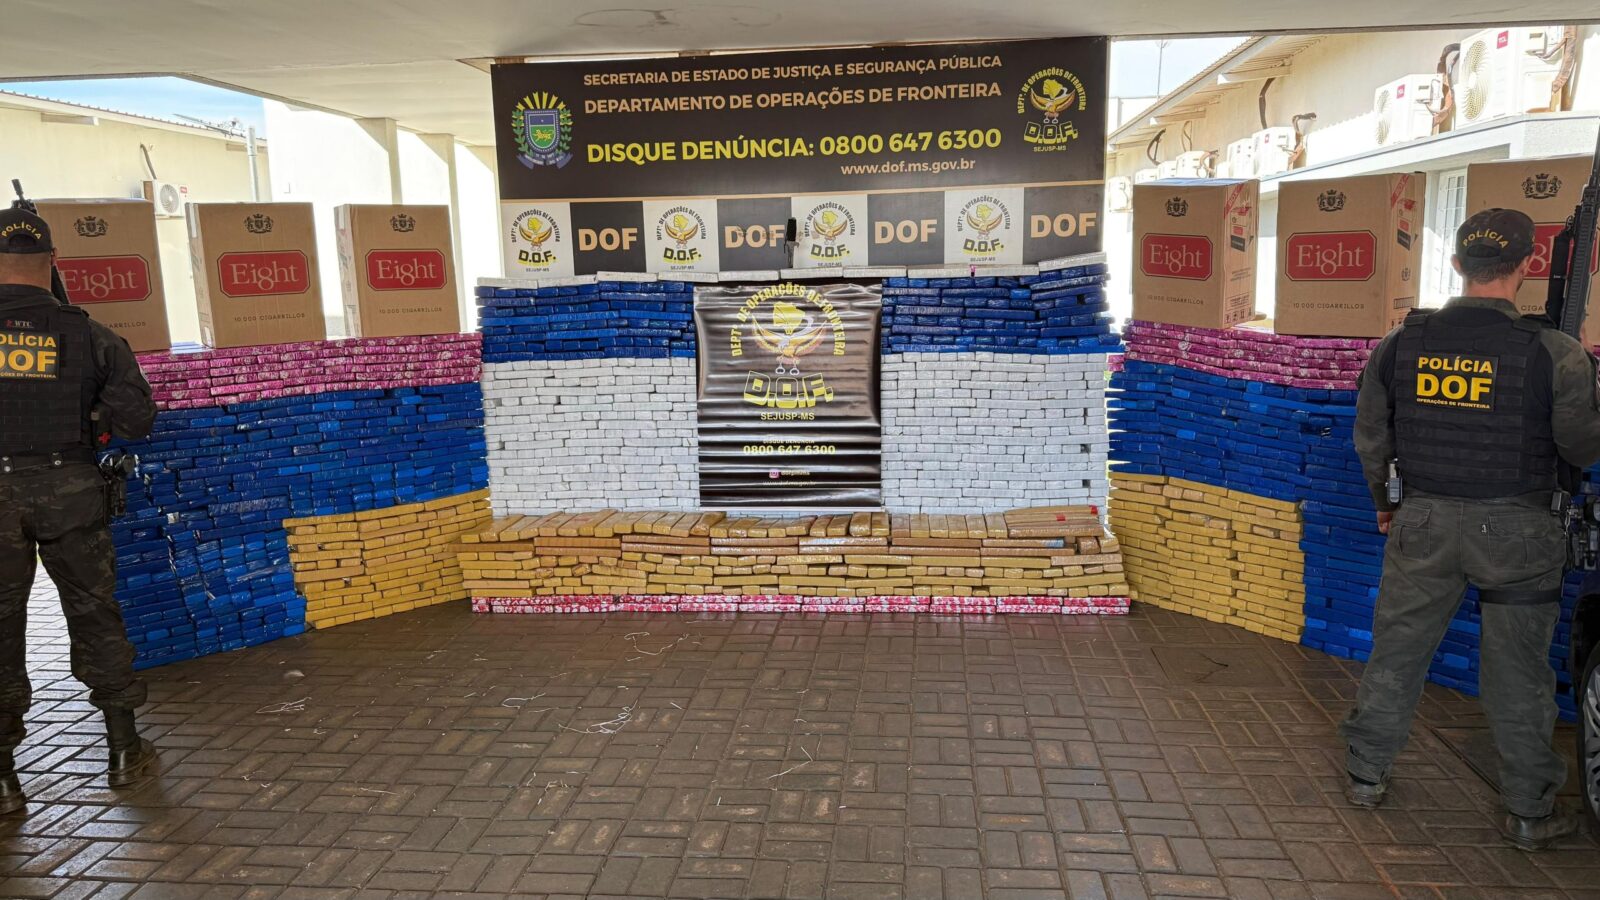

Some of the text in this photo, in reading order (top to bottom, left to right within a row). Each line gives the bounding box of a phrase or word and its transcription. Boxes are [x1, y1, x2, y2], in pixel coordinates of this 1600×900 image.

[584, 54, 1002, 86] SECRETARIA DE ESTADO DE JUSTIÇA E SEGURANÇA PÚBLICA
[1022, 84, 1030, 92] DE
[1064, 71, 1072, 80] DE
[584, 82, 1002, 114] DEPARTAMENTO DE OPERAÇÕES DE FRONTEIRA
[1024, 121, 1078, 144] D.O.F.
[588, 142, 676, 165] DISQUE
[682, 134, 814, 160] DENÚNCIA:
[820, 134, 883, 156] 0800
[889, 132, 932, 152] 647
[938, 128, 1002, 150] 6300
[841, 158, 976, 175] www.dof.ms.gov.br
[724, 224, 785, 248] DOF
[874, 219, 937, 244] DOF
[1030, 212, 1096, 238] DOF
[578, 228, 638, 250] DOF
[964, 238, 1004, 254] D.O.F.
[1463, 228, 1508, 248] POLÍCIA
[518, 250, 558, 264] D.O.F.
[664, 247, 702, 262] D.O.F.
[811, 244, 850, 259] D.O.F.
[1149, 244, 1203, 274] Eight
[1296, 242, 1364, 275] Eight
[60, 266, 138, 298] Eight
[229, 260, 298, 290] Eight
[376, 258, 437, 286] Eight
[736, 307, 750, 322] DE
[807, 290, 822, 305] DE
[0, 332, 56, 348] OLÍCIA
[0, 350, 56, 372] OF
[1418, 356, 1492, 373] POLÍCIA
[744, 370, 833, 408] D.O.F.
[1417, 373, 1492, 401] DOF
[760, 412, 814, 420] SEJUSP-MS
[744, 446, 836, 454] 0800 647 6300
